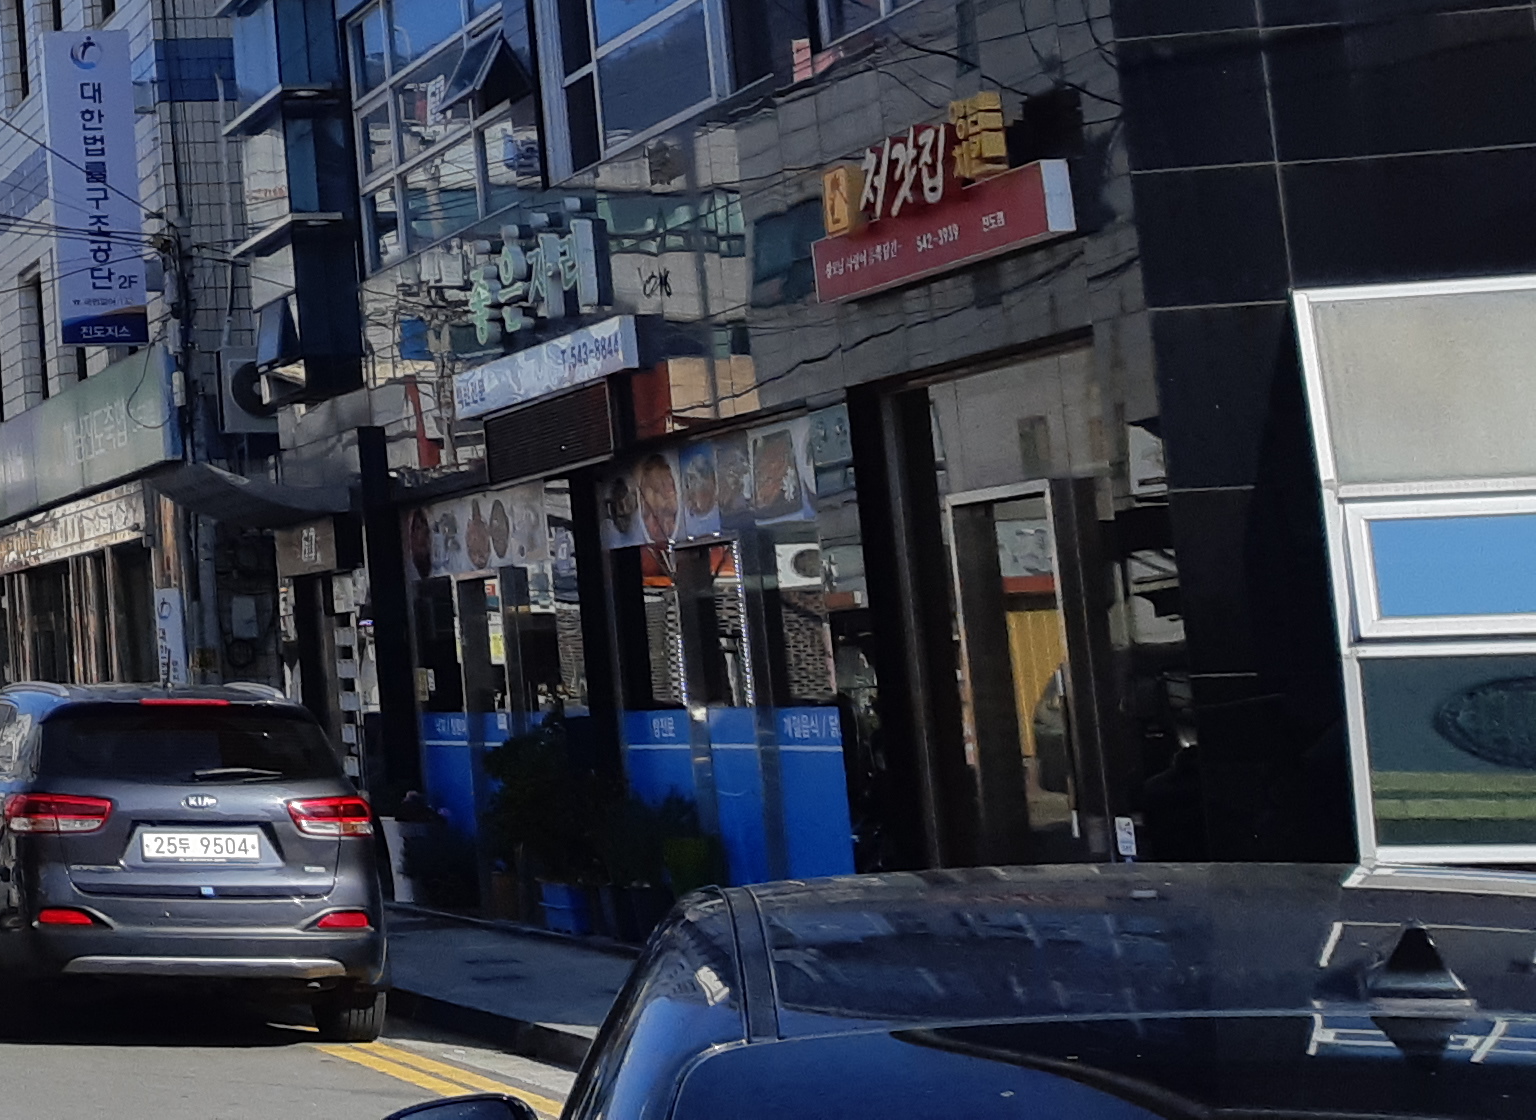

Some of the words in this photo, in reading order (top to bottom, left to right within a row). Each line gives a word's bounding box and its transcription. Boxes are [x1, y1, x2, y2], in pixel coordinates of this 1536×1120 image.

[859, 122, 945, 219] 처갓집
[916, 223, 960, 252] 542-3939
[118, 275, 138, 289] 2F
[468, 219, 597, 346] 좋은자리
[80, 326, 131, 339] 진도지소
[188, 796, 217, 806] KIA
[154, 836, 191, 855] 25두
[200, 836, 250, 856] 9504
